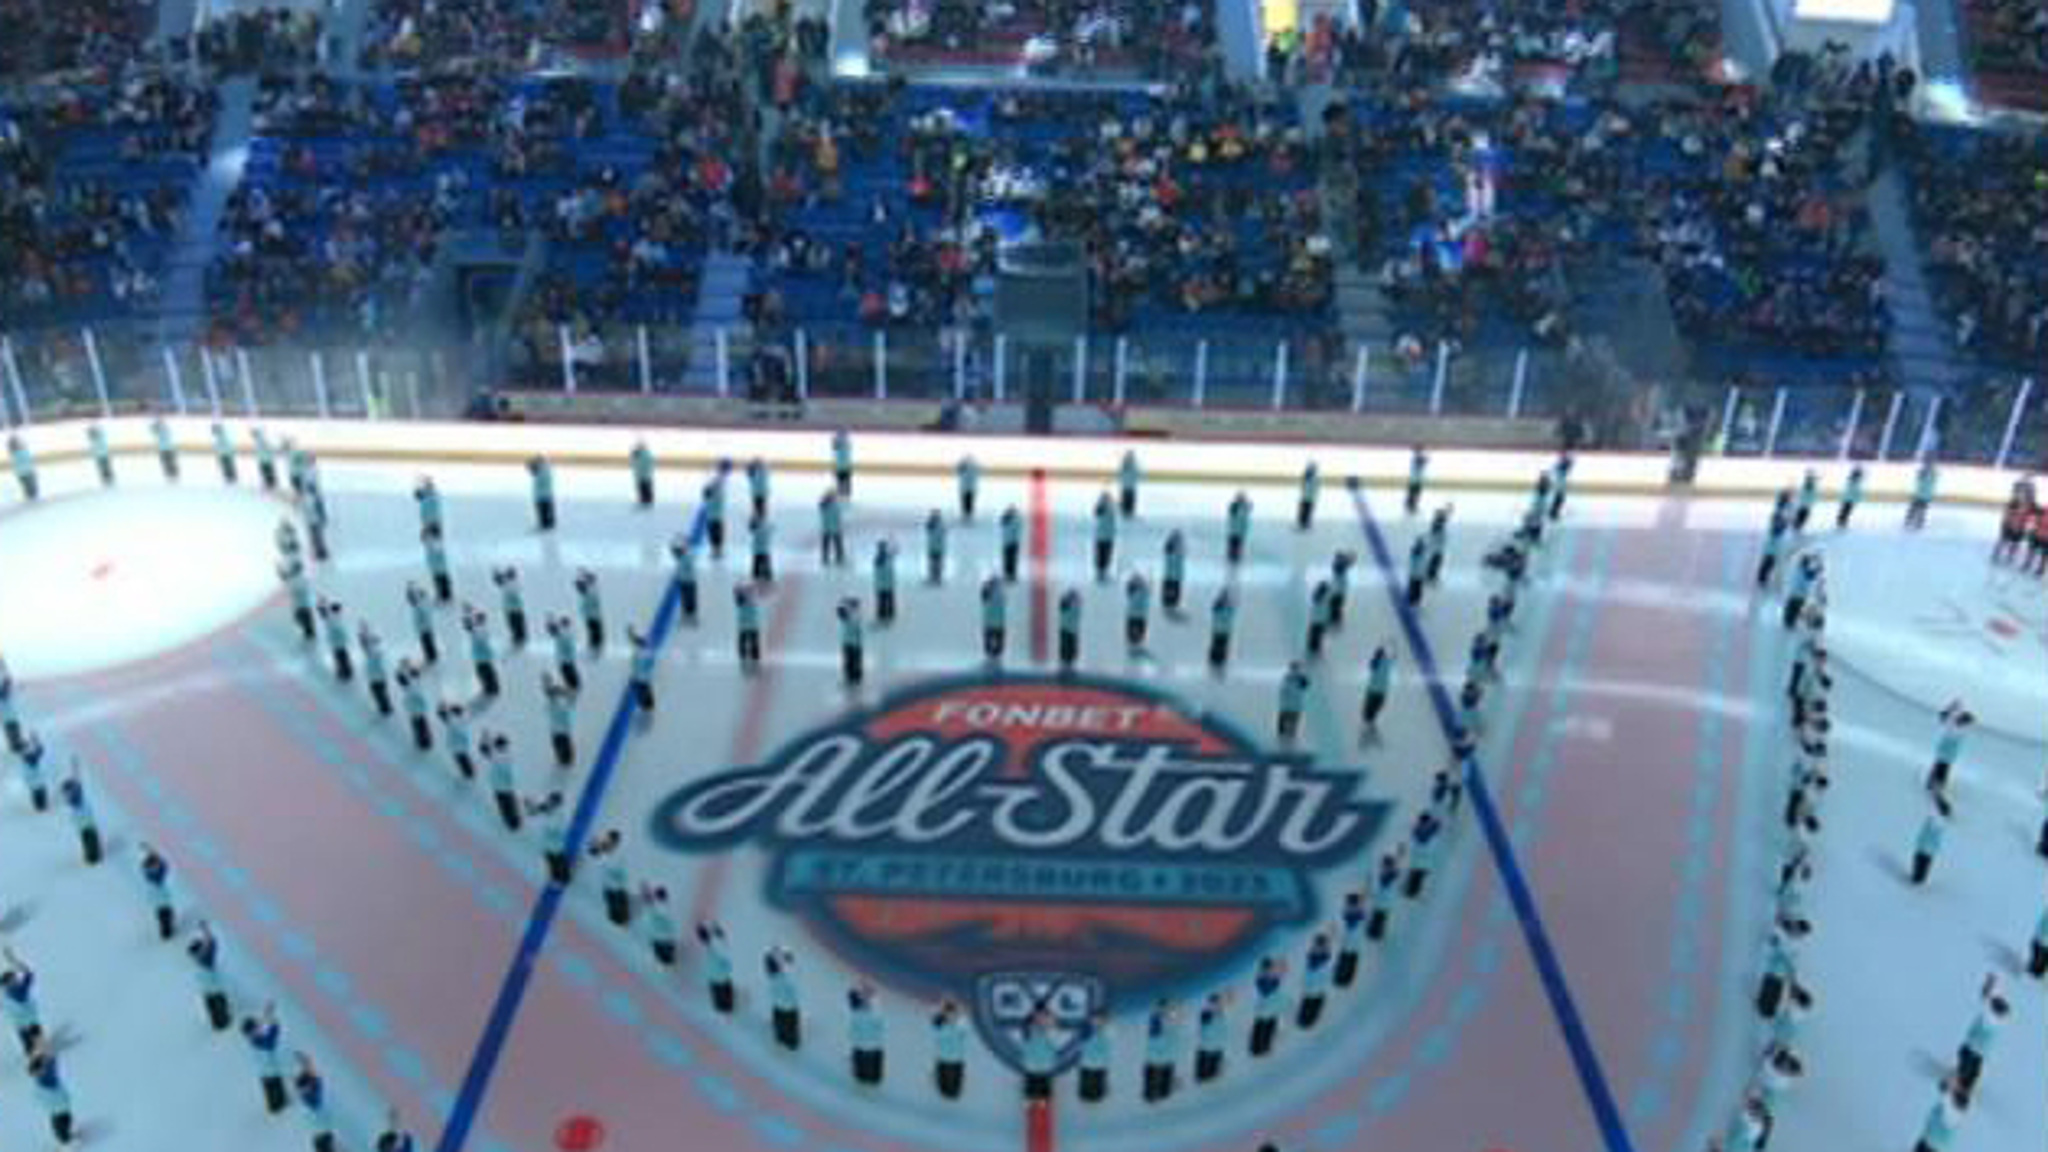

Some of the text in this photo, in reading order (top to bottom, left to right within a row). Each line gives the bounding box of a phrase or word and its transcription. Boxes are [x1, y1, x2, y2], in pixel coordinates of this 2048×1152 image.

[930, 699, 1150, 731] FONBET
[679, 735, 1359, 851] All-Star
[880, 859, 1142, 893] PETERSBURG
